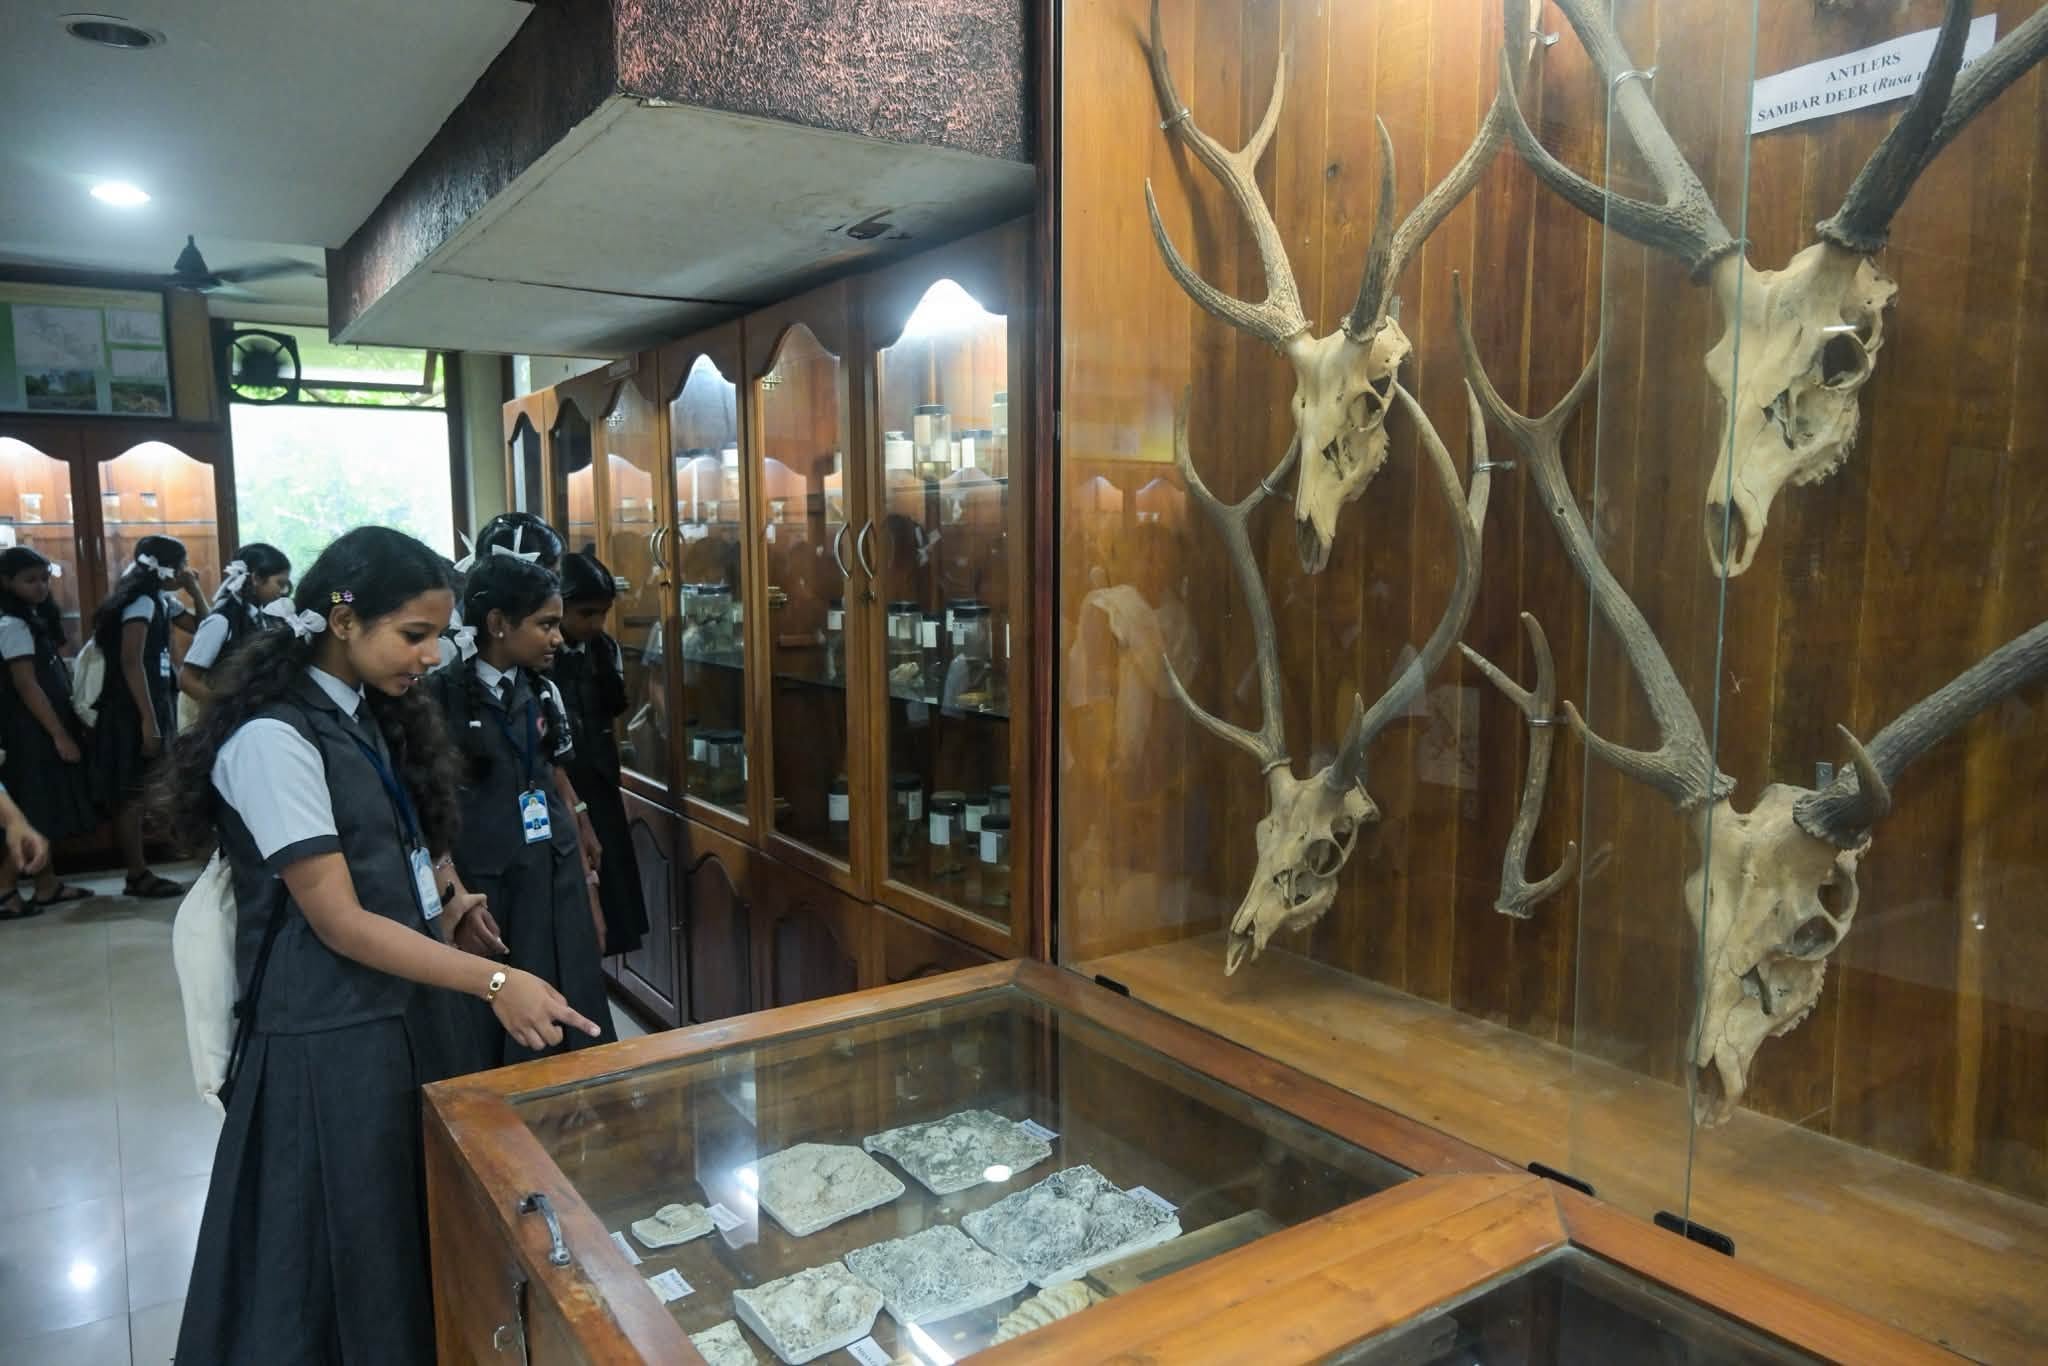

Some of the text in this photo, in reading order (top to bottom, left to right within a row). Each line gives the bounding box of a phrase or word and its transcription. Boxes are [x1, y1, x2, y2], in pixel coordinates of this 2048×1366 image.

[1826, 52, 1901, 83] ANTLERS
[1757, 72, 1912, 122] SAMBAR DEER (Rusa
